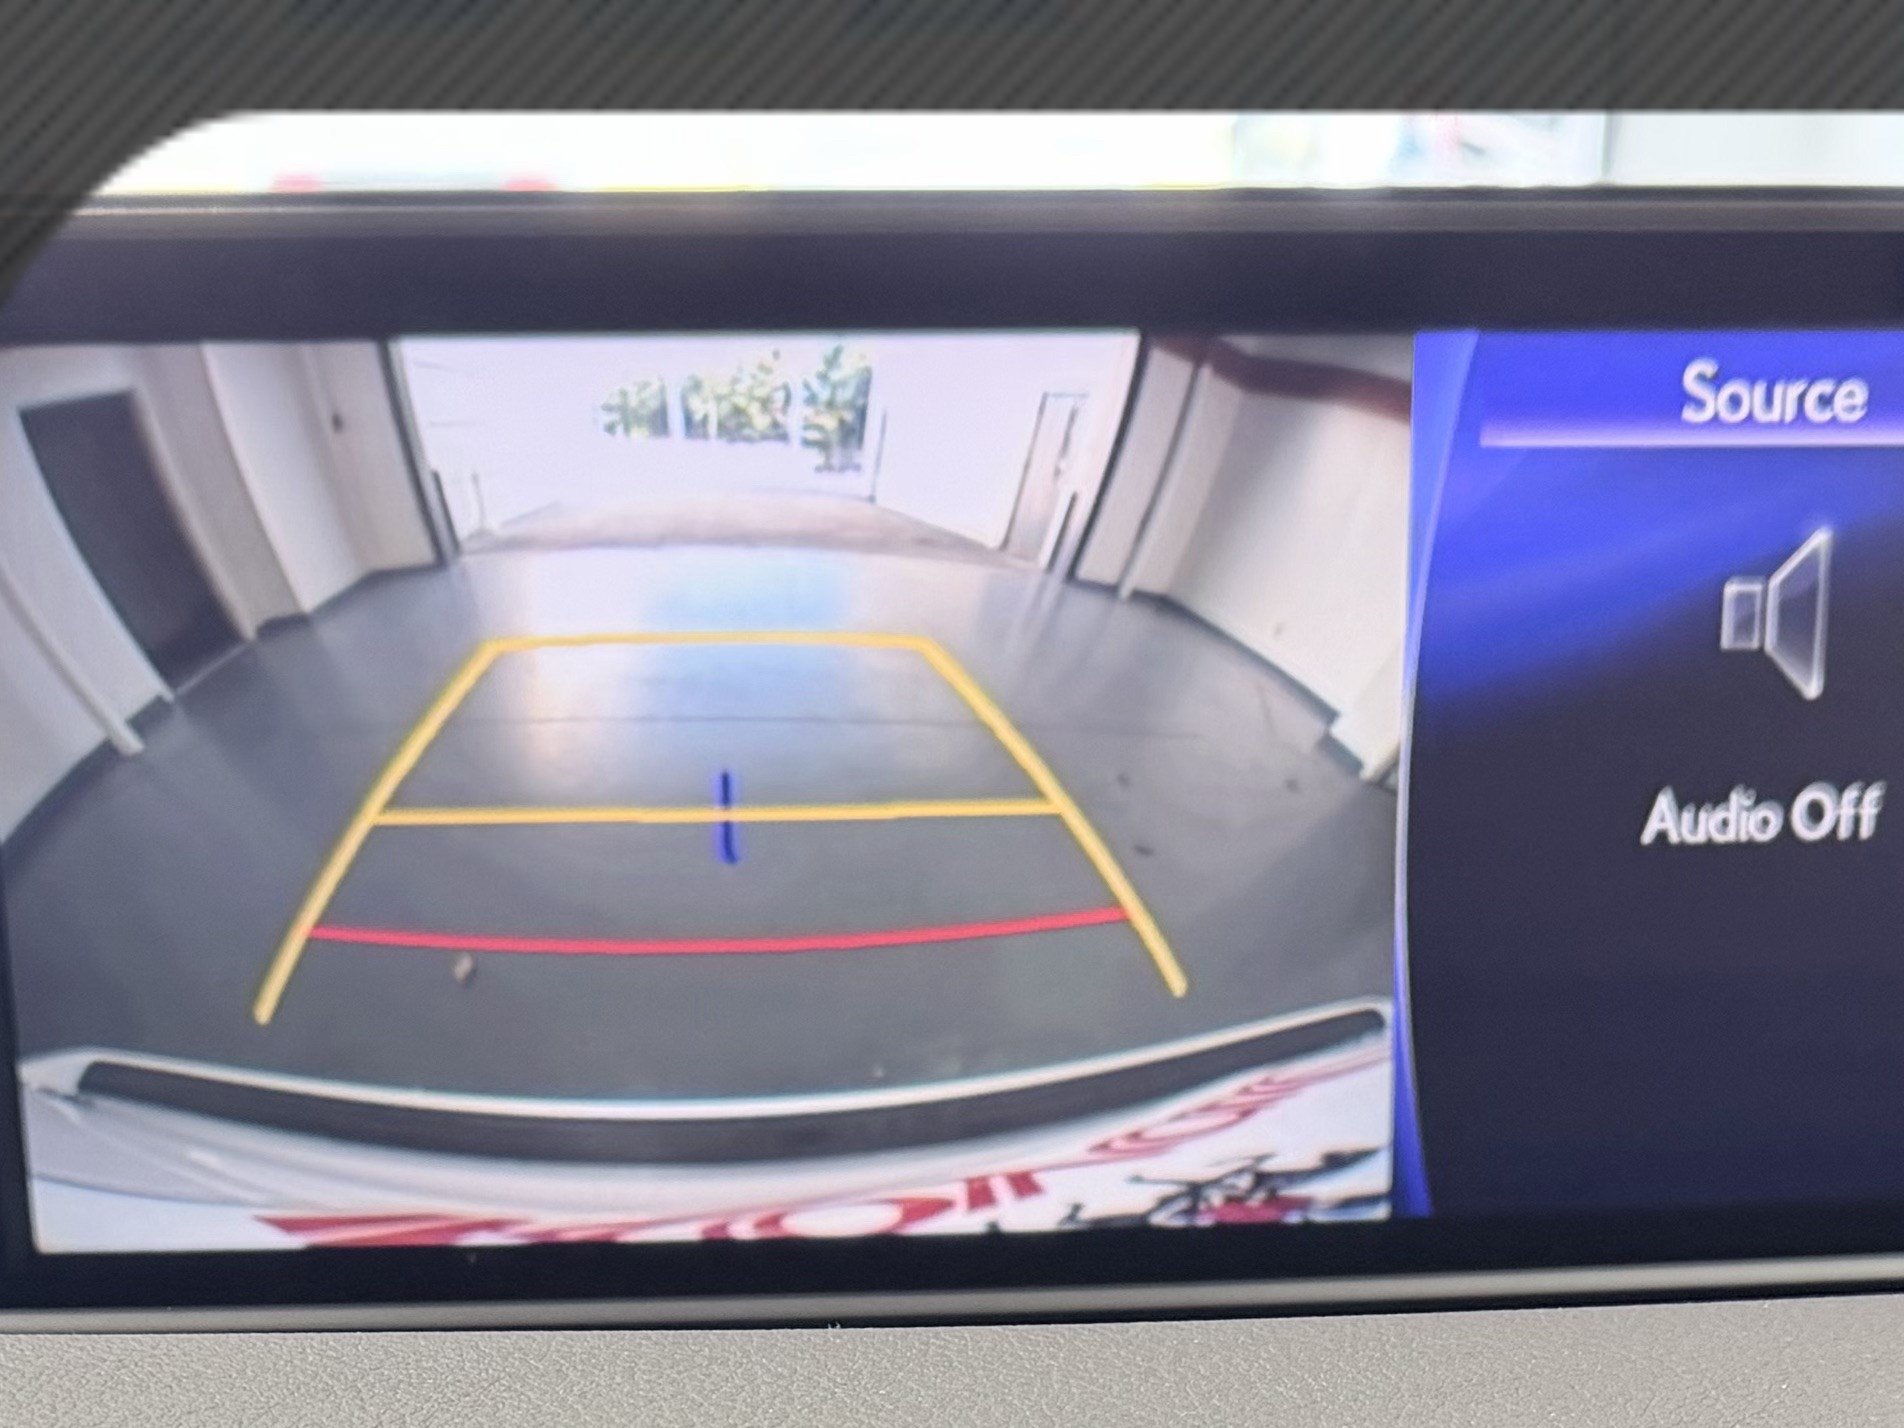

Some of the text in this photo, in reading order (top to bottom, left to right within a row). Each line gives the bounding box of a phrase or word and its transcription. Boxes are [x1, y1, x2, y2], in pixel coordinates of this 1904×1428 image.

[1679, 359, 1869, 426] Source
[1641, 780, 1887, 847] Audio Off
